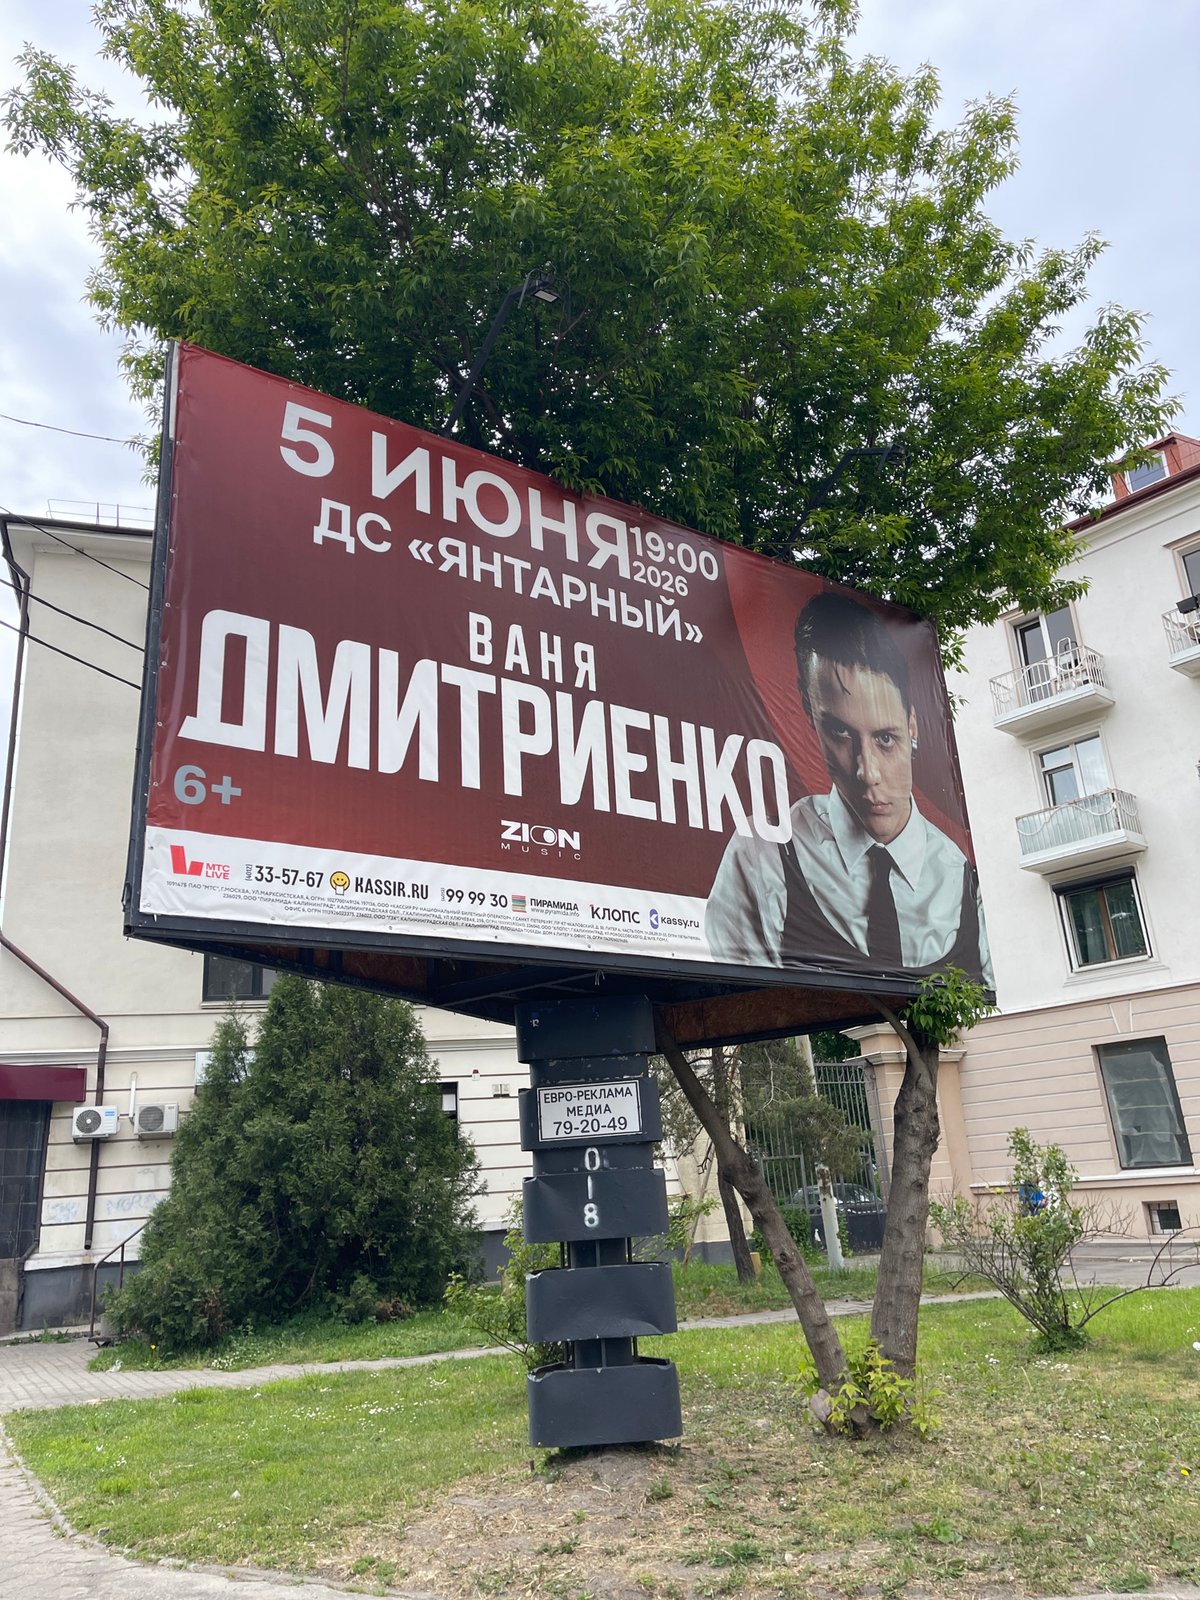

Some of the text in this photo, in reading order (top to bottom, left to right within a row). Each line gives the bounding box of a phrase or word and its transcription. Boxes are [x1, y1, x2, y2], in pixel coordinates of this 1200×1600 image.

[279, 401, 631, 579] 5 ИЮНЯ
[630, 526, 719, 582] 19:00
[313, 498, 704, 644] ДС «ЯНТАРНЫЙ»
[632, 560, 690, 597] 2026
[468, 611, 597, 692] ВАНЯ
[178, 609, 793, 844] ДМИТРИЕНКО
[173, 764, 242, 805] 6+
[501, 820, 580, 850] ZION
[501, 842, 580, 860] MUSIC
[254, 865, 324, 888] 33-57-67
[355, 876, 428, 900] KASSIR.RU
[446, 888, 508, 908] 99 99 30
[530, 898, 579, 911] ПИРАМИДА
[660, 916, 700, 928] kassy.ru
[544, 1086, 632, 1104] ЕВРО-РЕКЛАМА
[566, 1104, 612, 1118] МЕДИА
[553, 1116, 628, 1136] 79-20-49
